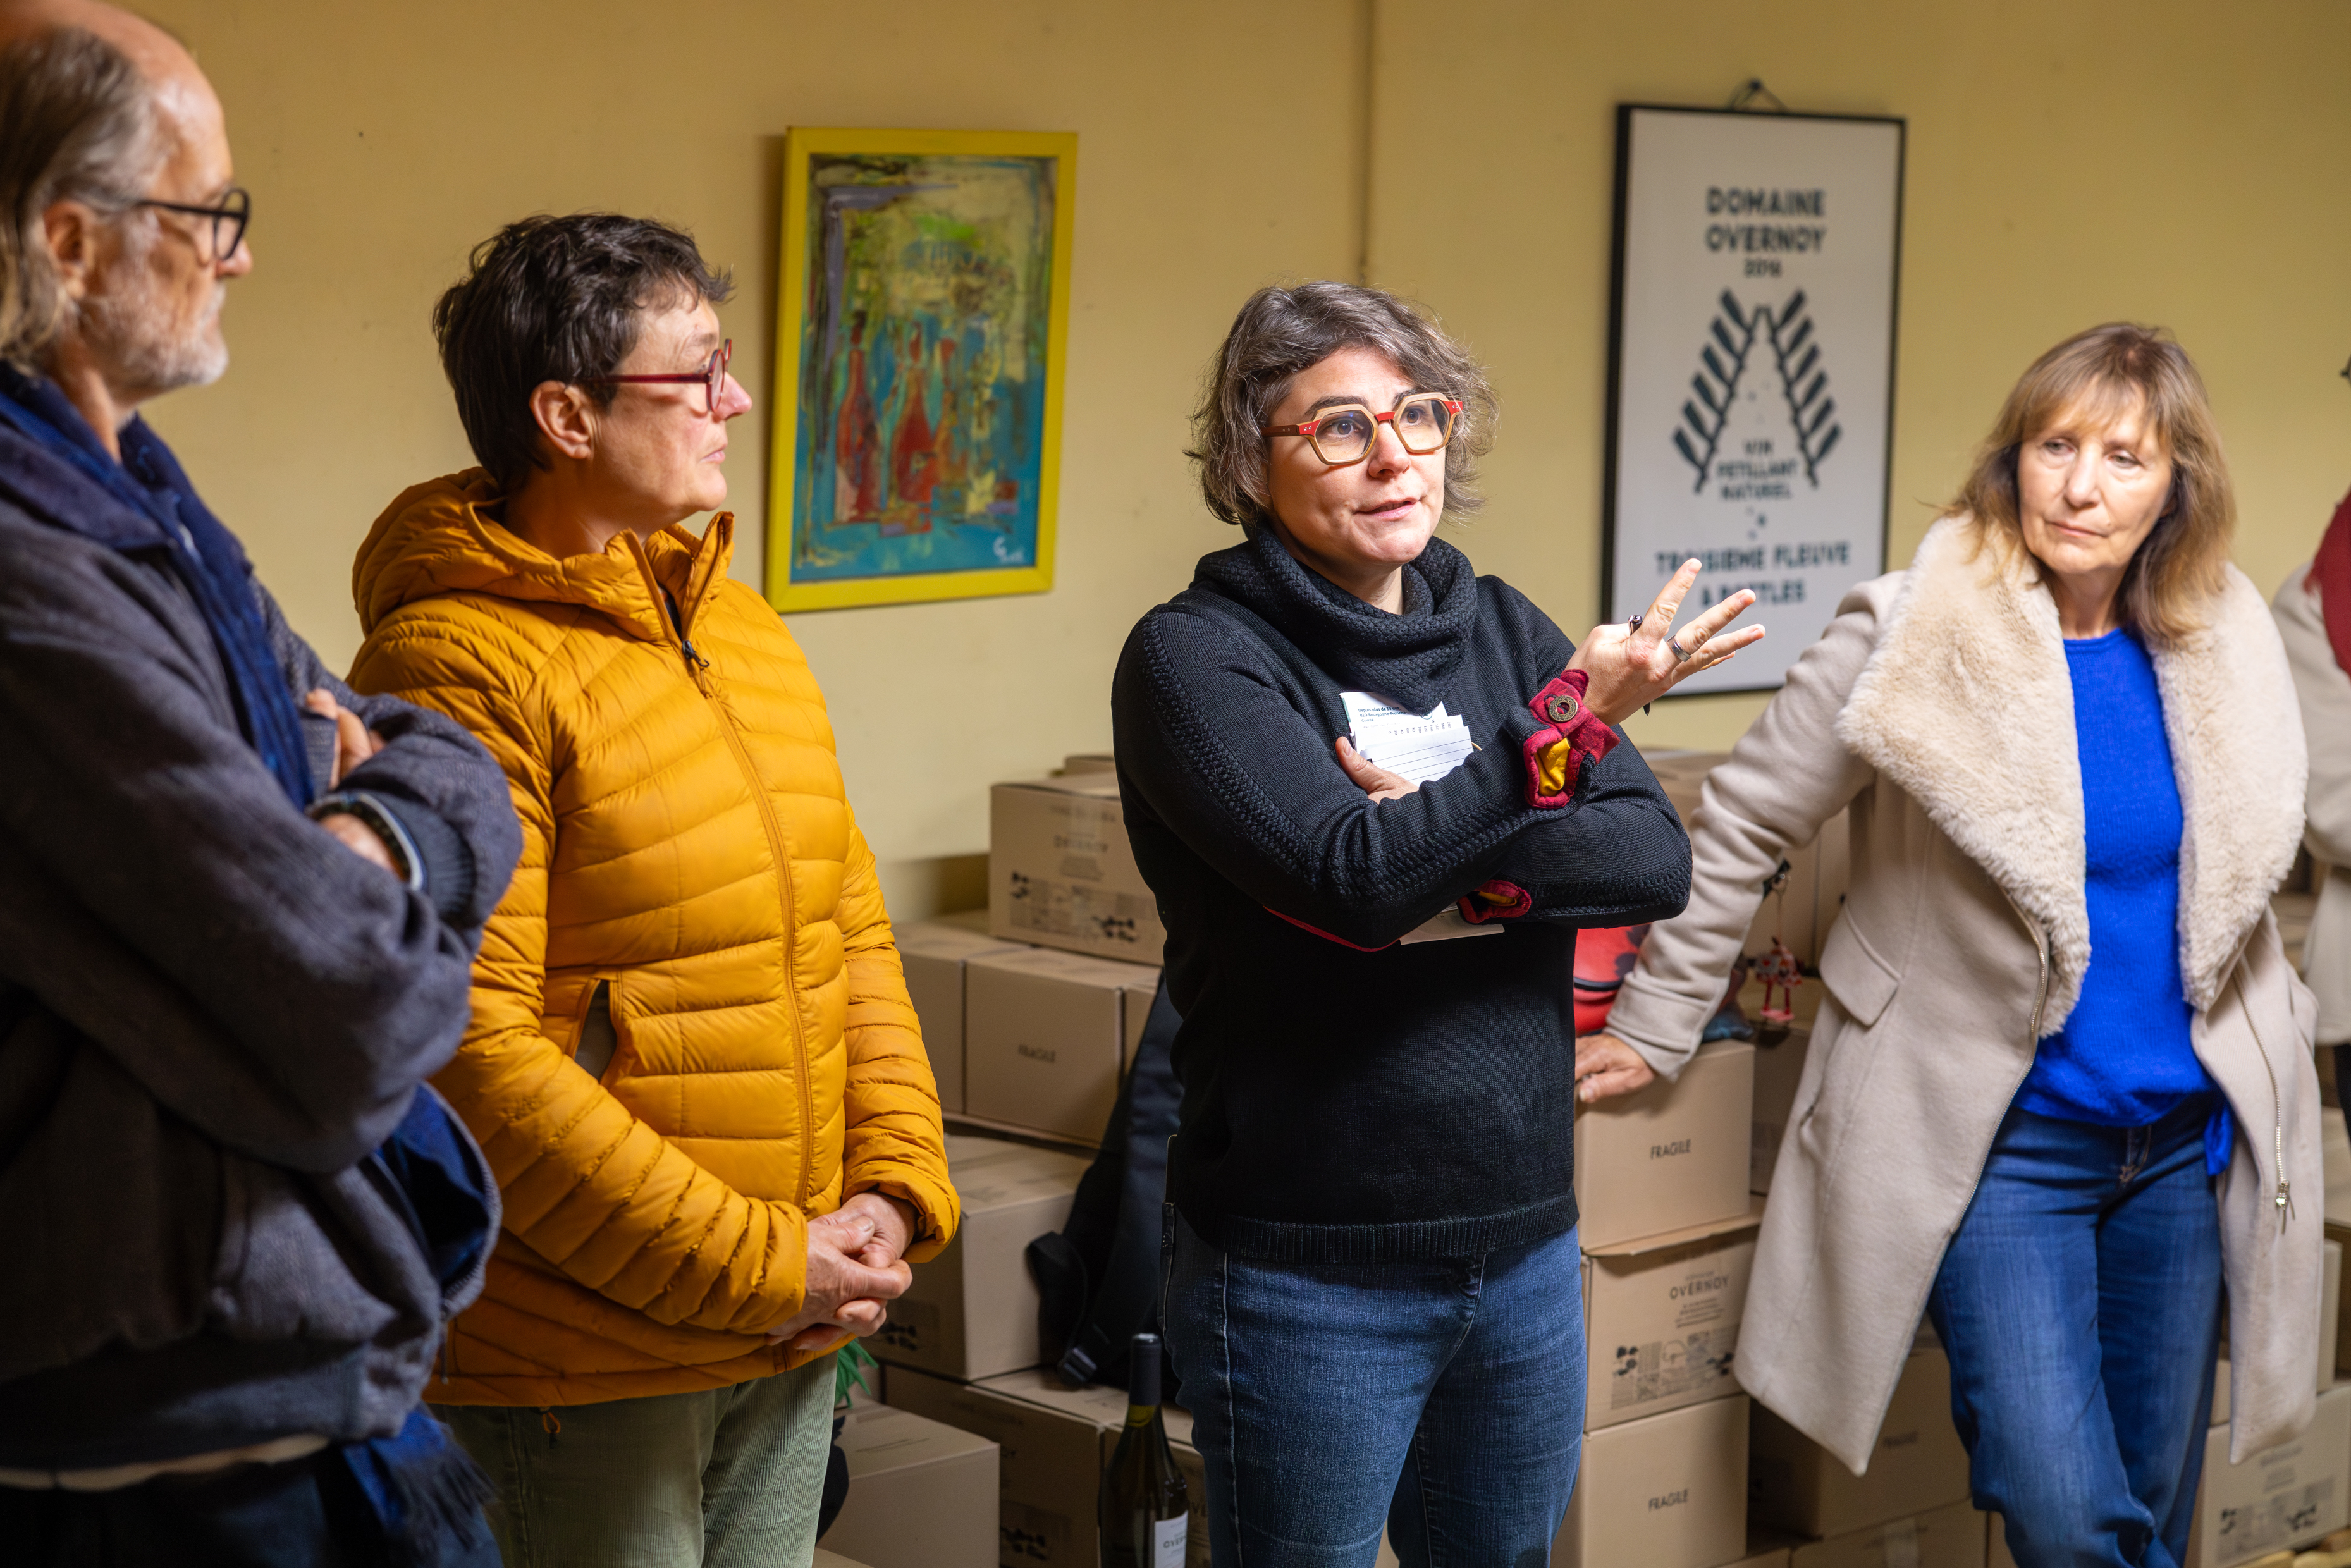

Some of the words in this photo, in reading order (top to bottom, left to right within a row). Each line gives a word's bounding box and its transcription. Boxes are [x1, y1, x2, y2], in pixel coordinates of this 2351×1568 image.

[1706, 186, 1826, 216] DOMAINE
[1705, 224, 1827, 254] OVERNOY
[1744, 439, 1773, 455] VIN
[1721, 482, 1793, 501] NATUREL
[1774, 540, 1850, 570] FLEUVE
[1650, 1139, 1691, 1160] FRAGILE
[1669, 1275, 1729, 1300] OVERNOY
[1648, 1488, 1689, 1513] FRAGILE
